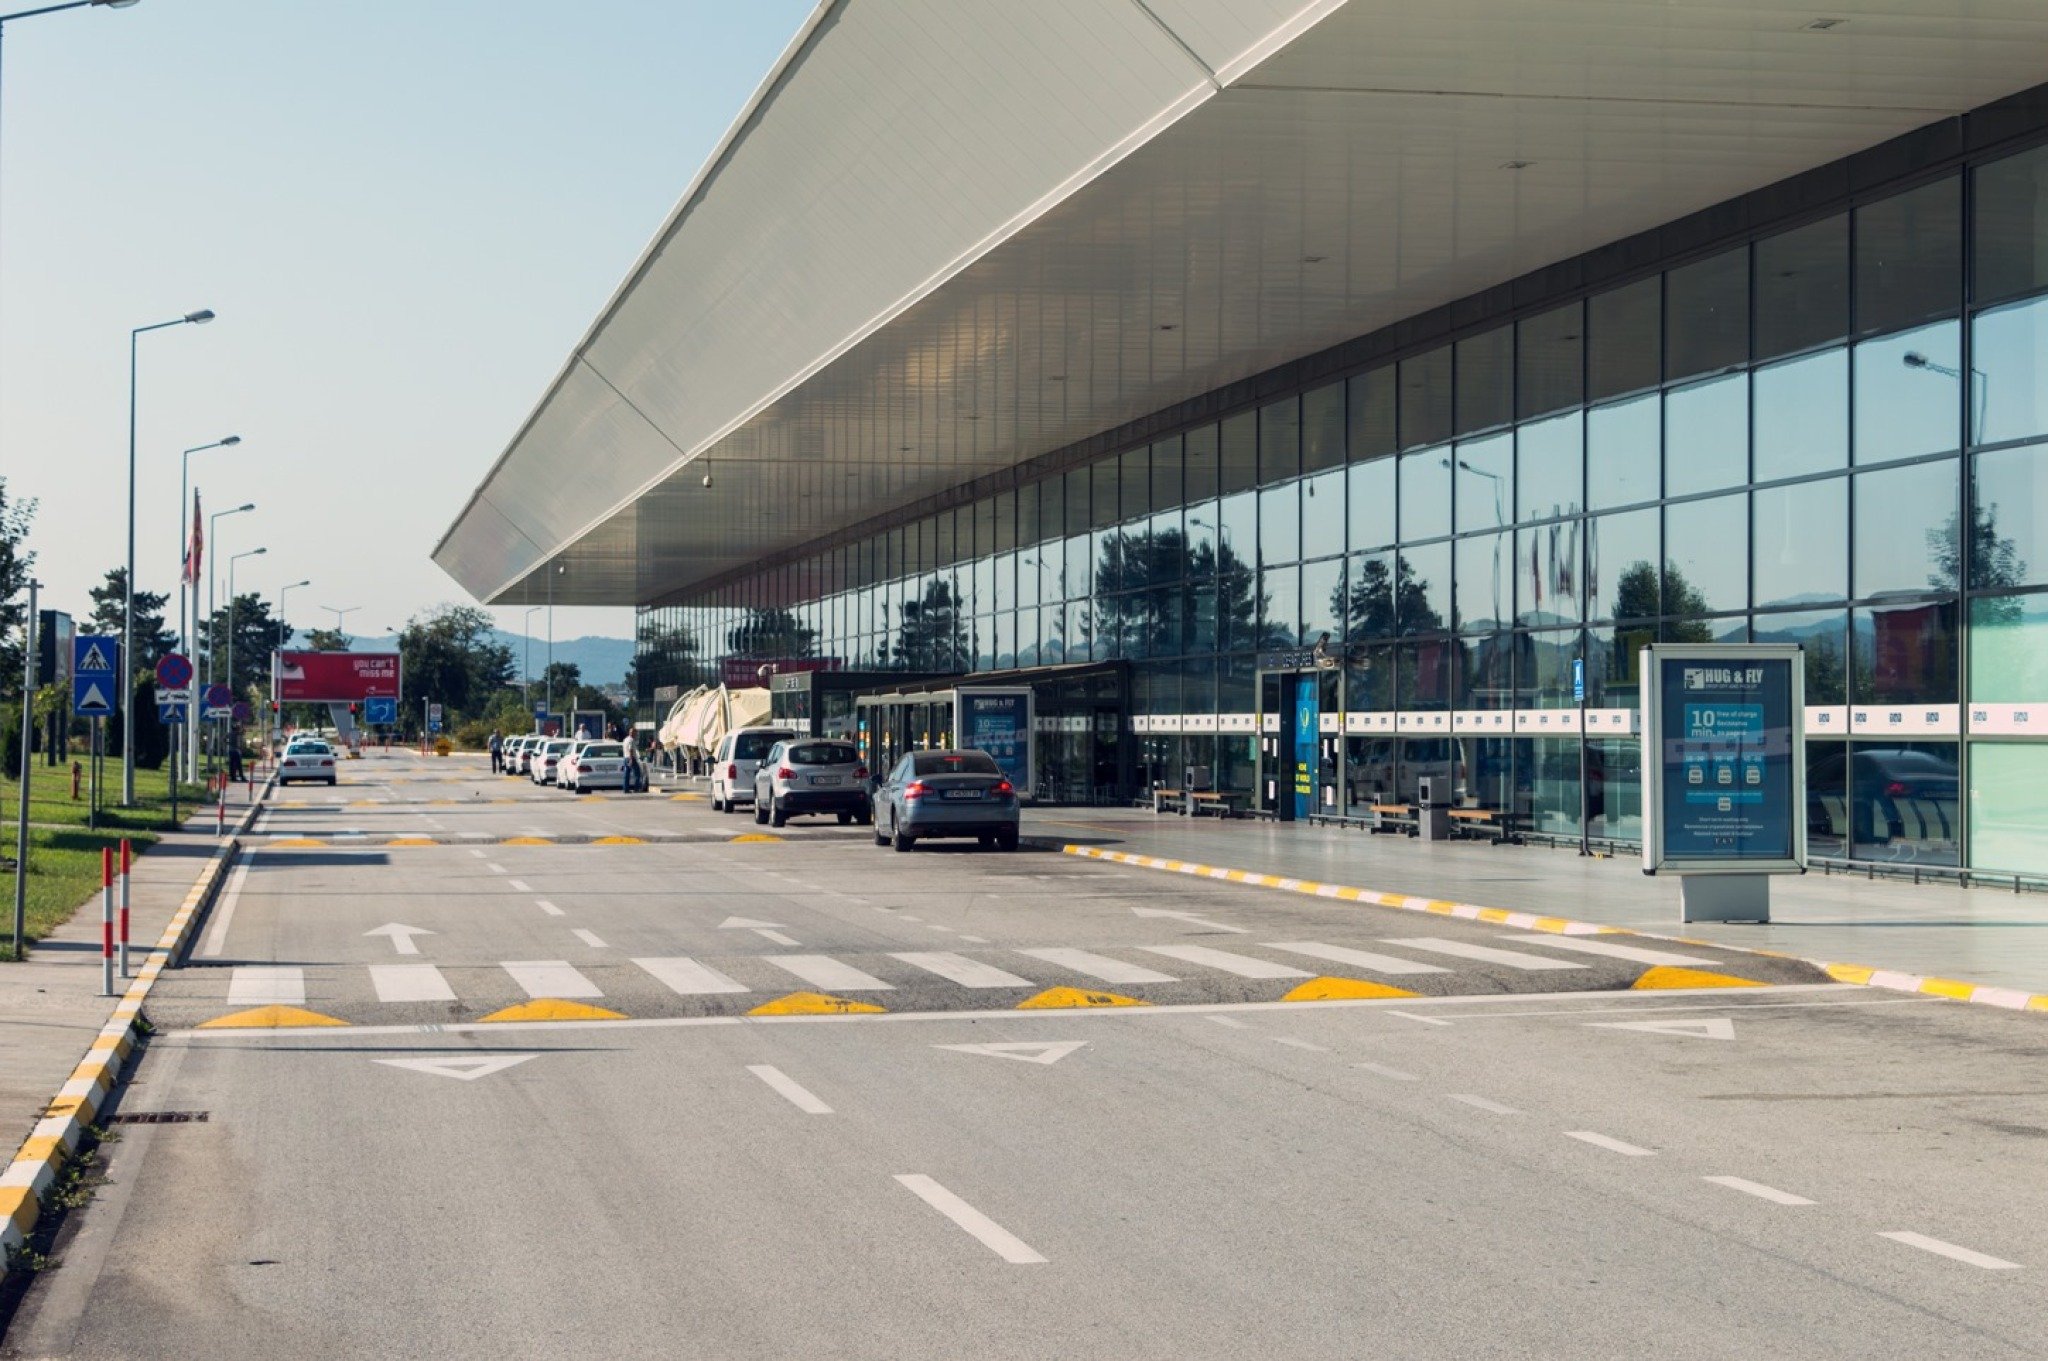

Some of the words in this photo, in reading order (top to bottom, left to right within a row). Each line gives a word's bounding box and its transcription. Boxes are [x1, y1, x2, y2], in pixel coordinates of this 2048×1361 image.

[353, 659, 370, 671] you
[359, 669, 380, 678] miss
[381, 669, 395, 678] me
[1705, 668, 1731, 683] HUG
[1733, 670, 1744, 684] &
[1746, 668, 1764, 683] FLY
[978, 718, 990, 727] 10
[1691, 710, 1716, 727] 10
[1691, 726, 1717, 737] min.
